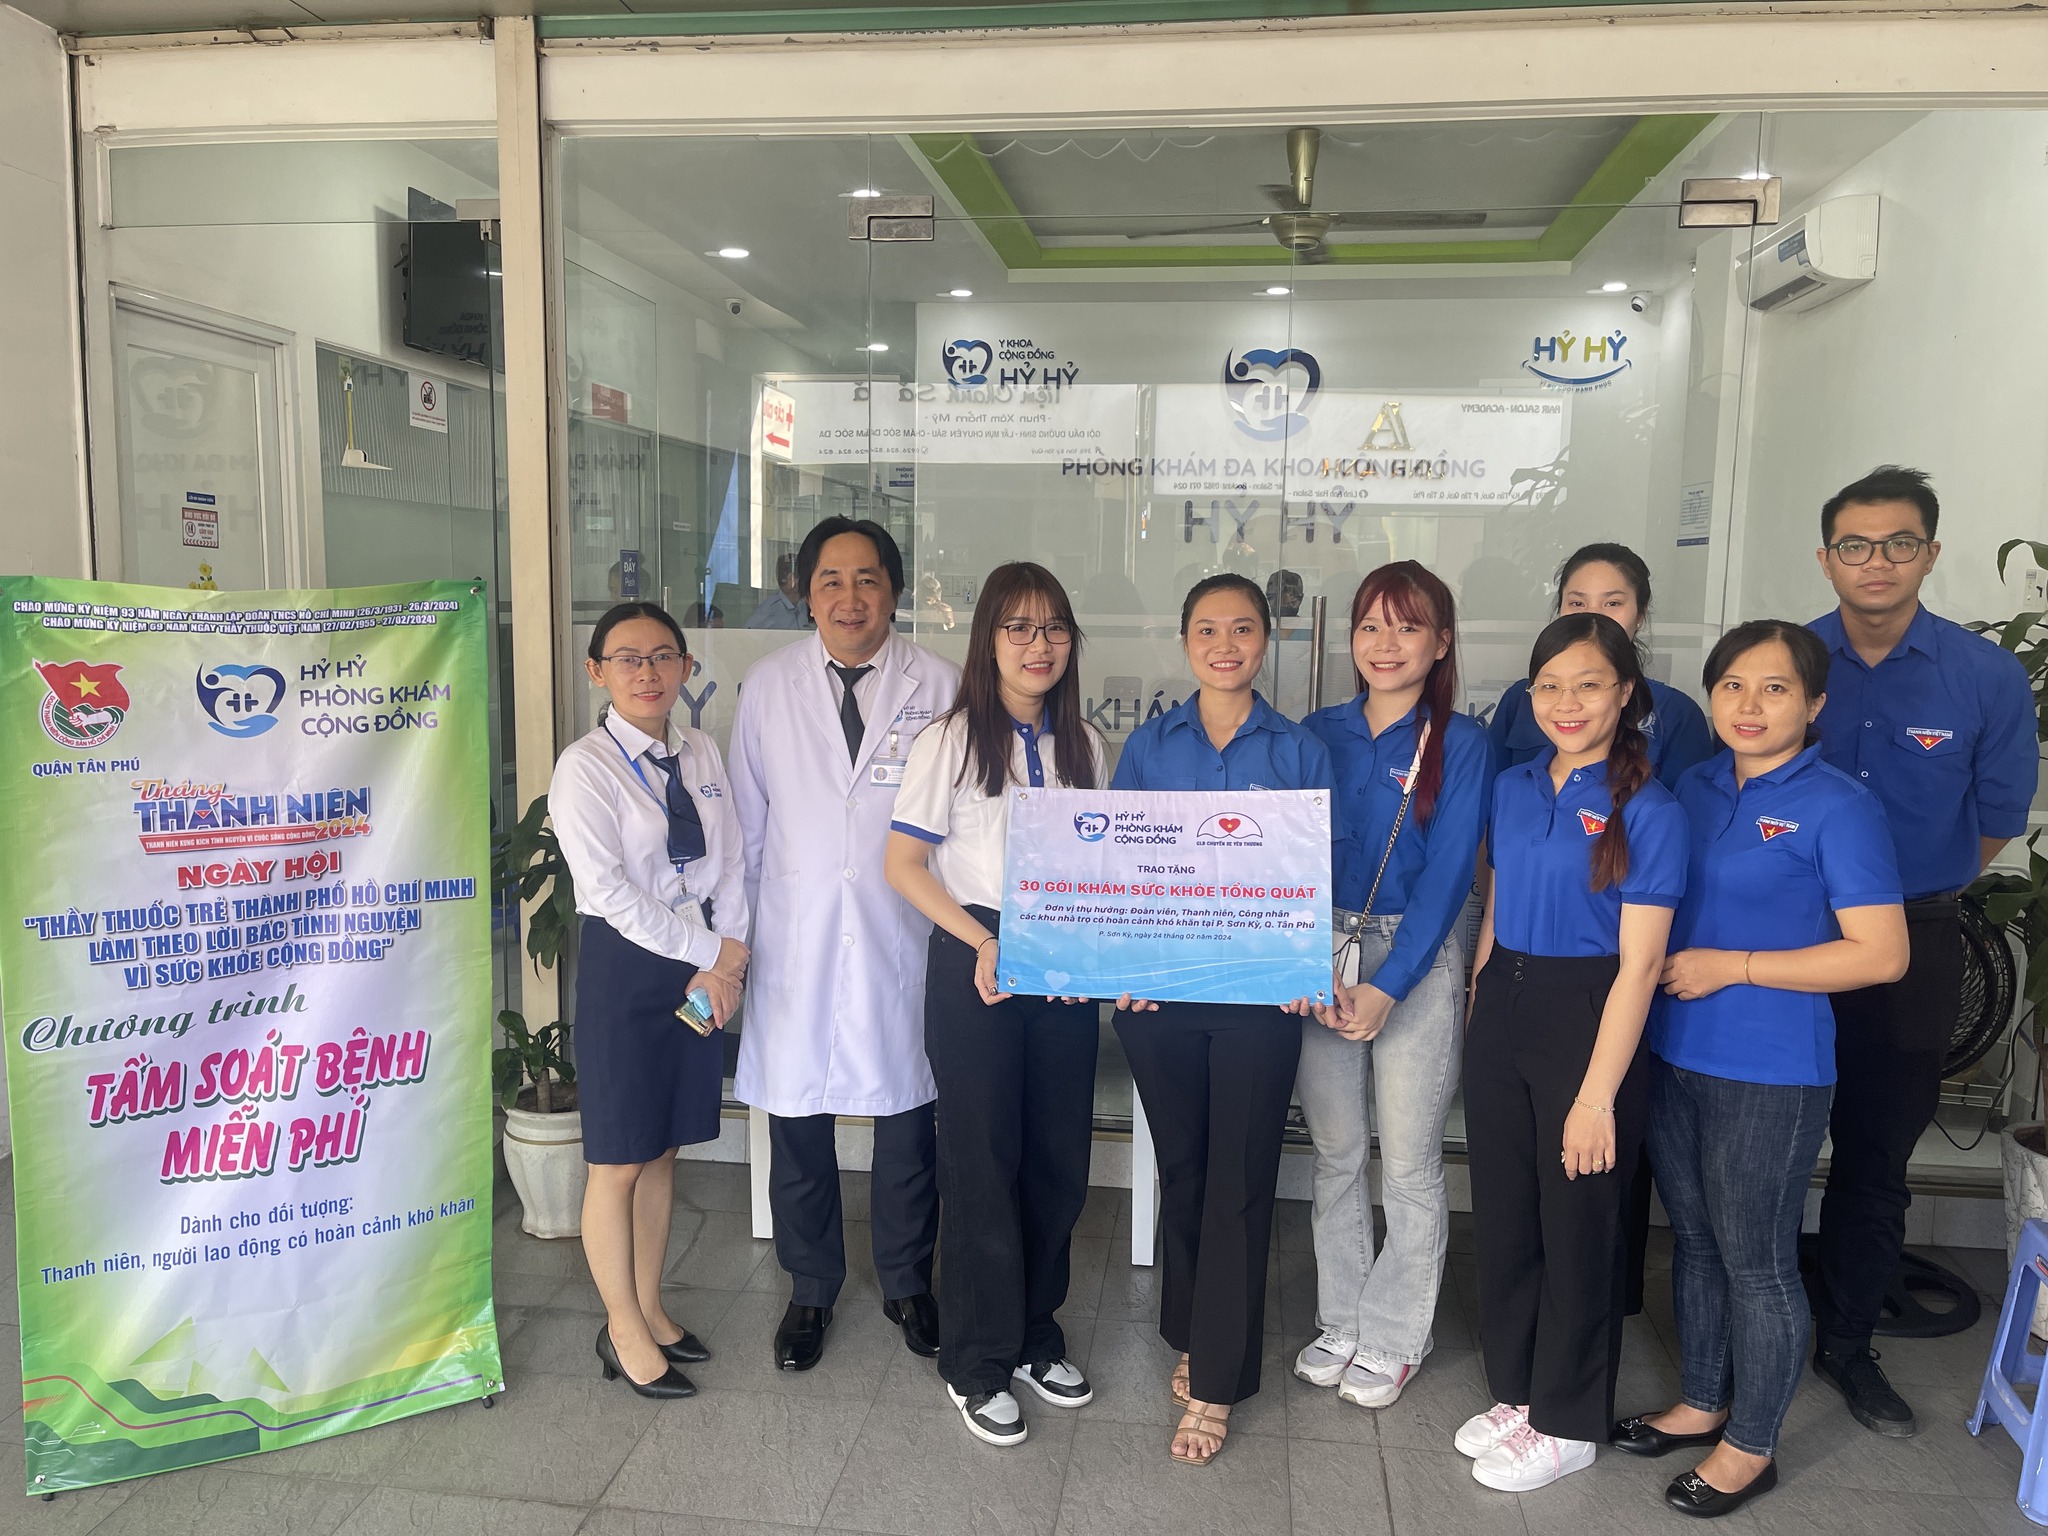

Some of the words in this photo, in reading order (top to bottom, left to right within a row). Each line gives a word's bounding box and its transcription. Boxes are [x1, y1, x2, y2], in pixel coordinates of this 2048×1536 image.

[998, 339, 1005, 348] Y
[1006, 339, 1033, 348] KHOA
[998, 349, 1025, 361] CỘNG
[1533, 329, 1577, 362] HỶ
[1583, 329, 1627, 362] HỶ
[1000, 361, 1036, 390] HỶ
[1043, 361, 1079, 390] HỶ
[1062, 452, 1143, 476] PHÒNG
[1151, 452, 1216, 477] KHÁM
[1224, 458, 1256, 477] ĐA
[1264, 457, 1331, 477] KHOA
[1184, 487, 1259, 543] HỶ
[1280, 485, 1356, 543] HỶ
[624, 577, 636, 588] Push
[13, 601, 42, 613] CHÀO
[44, 602, 75, 614] MỪNG
[93, 605, 119, 618] NIỆM
[121, 605, 135, 618] 93
[138, 606, 160, 619] NĂM
[162, 608, 188, 621] NGÀY
[245, 610, 271, 621] ĐOÀN
[272, 609, 297, 621] TNCS
[314, 607, 330, 620] CHÍ
[331, 608, 355, 619] MINH
[42, 615, 71, 628] CHÀO
[122, 620, 147, 634] NIỆM
[166, 622, 188, 633] NĂM
[190, 621, 217, 633] NGÀY
[300, 622, 320, 633] NAM
[300, 657, 331, 681] HỶ
[336, 653, 367, 678] HỶ
[300, 684, 384, 707] PHÒNG
[390, 680, 451, 703] KHÁM
[301, 712, 369, 738] CỘNG
[374, 706, 438, 732] ĐỒNG
[32, 760, 72, 777] QUẬN
[77, 758, 106, 773] TÂN
[111, 756, 140, 772] PHÚ
[131, 777, 233, 804] Tháng
[133, 795, 278, 833] THANH
[287, 787, 370, 824] NIÊN
[314, 815, 371, 841] 2024
[1114, 834, 1144, 845] CỘNG
[1145, 833, 1177, 844] ĐỒNG
[1115, 823, 1151, 833] PHÒNG
[1153, 824, 1183, 833] KHÁM
[177, 857, 274, 888] NGÀY
[284, 849, 341, 880] HỘI
[1137, 865, 1165, 874] TRAO
[1167, 864, 1196, 876] TẶNG
[1019, 880, 1040, 892] 30
[1045, 879, 1072, 893] GÓI
[1077, 881, 1126, 895] KHÁM
[1130, 882, 1165, 896] SỨC
[1220, 882, 1266, 898] TỔNG
[1270, 885, 1316, 899] QUÁT
[24, 907, 96, 939] "THẦY
[101, 900, 180, 933] THUỐC
[186, 896, 227, 924] TRẺ
[232, 891, 299, 920] THÀNH
[305, 880, 345, 908] PHỐ
[351, 878, 378, 905] HỒ
[384, 879, 420, 902] CHÍ
[424, 877, 474, 900] MINH
[1020, 912, 1036, 921] các
[1038, 913, 1056, 922] khu
[1058, 914, 1075, 922] nhà
[1077, 915, 1091, 924] trọ
[1093, 915, 1104, 924] có
[1106, 916, 1129, 925] hoàn
[1157, 917, 1174, 926] khó
[1176, 918, 1199, 927] khăn
[1202, 919, 1215, 928] tại
[1227, 920, 1246, 928] Sơn
[1277, 920, 1294, 929] Tân
[1296, 921, 1315, 929] Phú
[1045, 904, 1064, 912] Đơn
[1076, 905, 1092, 914] thụ
[1130, 906, 1154, 915] Đoàn
[1157, 907, 1179, 917] viên,
[1182, 909, 1210, 917] Thanh
[1213, 909, 1236, 918] niên,
[1238, 909, 1263, 919] Công
[1265, 910, 1289, 918] nhân
[89, 936, 136, 964] LÀM
[142, 932, 199, 957] THEO
[206, 925, 240, 950] LỜI
[246, 919, 286, 946] BÁC
[291, 911, 338, 936] TÌNH
[344, 907, 420, 935] NGUYỆN
[124, 963, 149, 989] VÌ
[155, 958, 202, 985] SỨC
[207, 950, 261, 979] KHỎE
[267, 941, 323, 969] CỘNG
[328, 934, 393, 961] ĐỒNG"
[22, 1011, 197, 1052] Chương
[208, 982, 308, 1025] trình
[87, 1053, 185, 1124] TẦM
[194, 1028, 308, 1104] SOÁT
[315, 1026, 429, 1097] BỆNH
[161, 1104, 279, 1183] MIỄN
[289, 1094, 369, 1170] PHÍ
[181, 1215, 222, 1235] Dành
[230, 1211, 260, 1230] cho
[269, 1203, 294, 1224] đối
[301, 1197, 353, 1219] tượng:
[41, 1259, 96, 1284] Thanh
[103, 1252, 146, 1273] niên,
[152, 1246, 197, 1271] người
[204, 1244, 231, 1263] lao
[238, 1237, 281, 1258] động
[288, 1231, 307, 1249] có
[315, 1223, 355, 1245] hoàn
[362, 1215, 401, 1236] cảnh
[408, 1206, 434, 1227] khó
[440, 1198, 475, 1218] khăn
